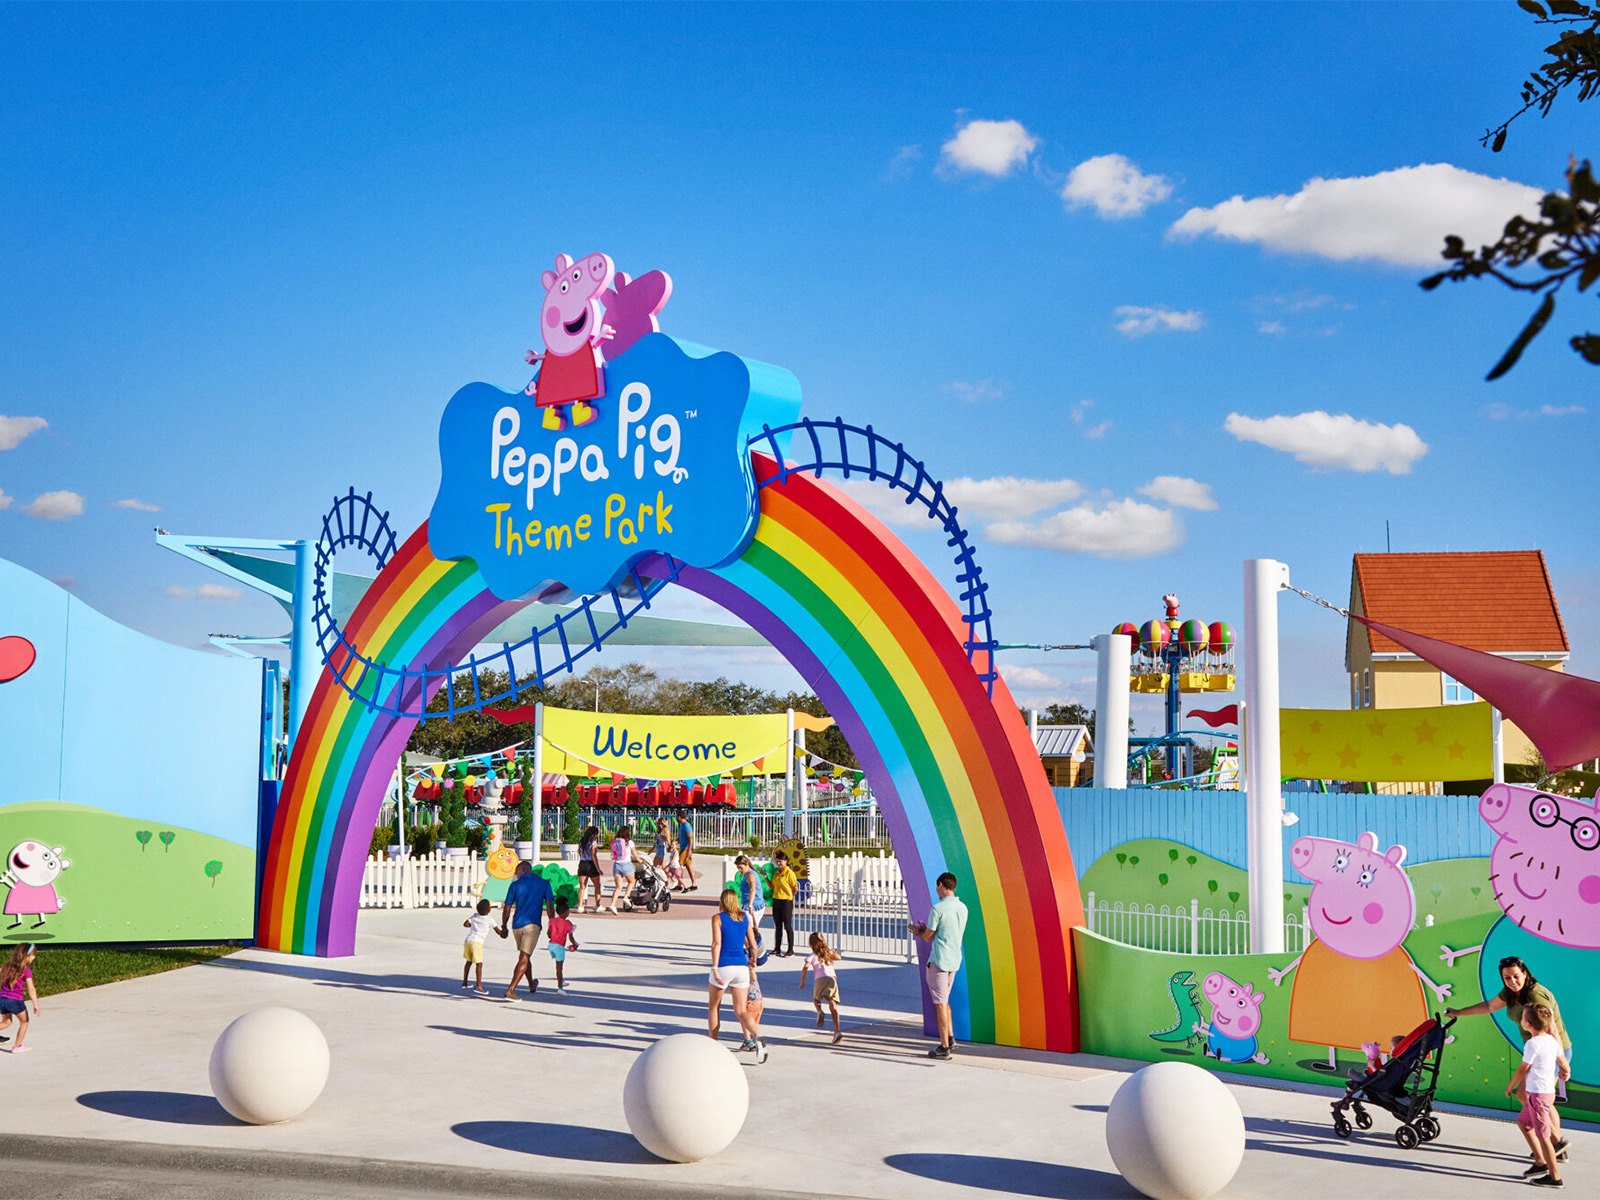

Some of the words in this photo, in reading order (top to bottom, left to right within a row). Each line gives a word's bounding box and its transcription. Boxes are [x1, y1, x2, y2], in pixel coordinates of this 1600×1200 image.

[491, 406, 609, 510] Peppa
[618, 382, 688, 484] Pig
[485, 503, 592, 555] Theme
[605, 490, 673, 544] Park
[593, 724, 737, 761] Welcome
